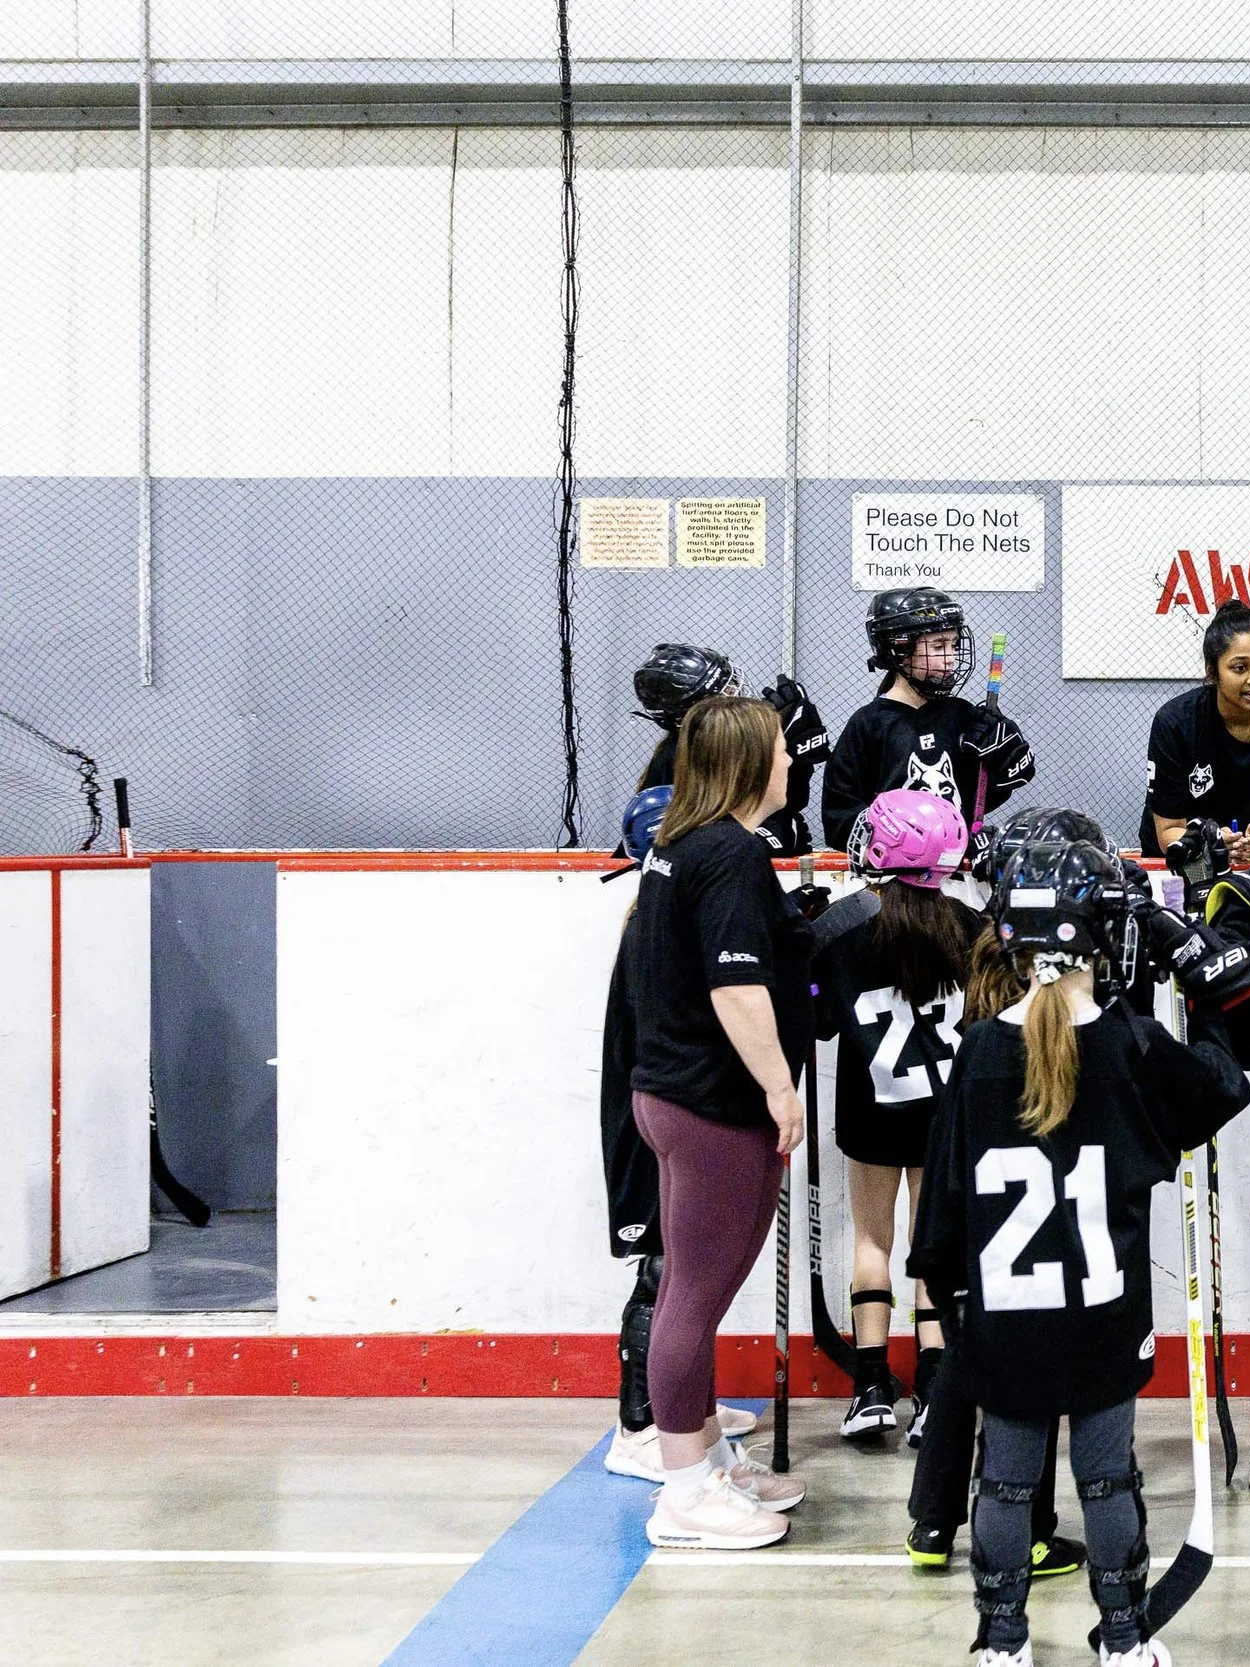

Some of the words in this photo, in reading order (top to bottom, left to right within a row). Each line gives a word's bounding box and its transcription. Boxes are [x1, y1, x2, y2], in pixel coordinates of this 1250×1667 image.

[866, 508, 938, 527] Please
[946, 508, 975, 527] Do
[983, 509, 1019, 528] Not
[866, 533, 928, 552] Touch
[934, 533, 975, 552] The
[983, 534, 1031, 553] Nets
[866, 562, 912, 577] Thank
[915, 563, 941, 577] You
[853, 980, 966, 1103] 23
[808, 1183, 823, 1276] BAUER
[974, 1144, 1125, 1312] 21
